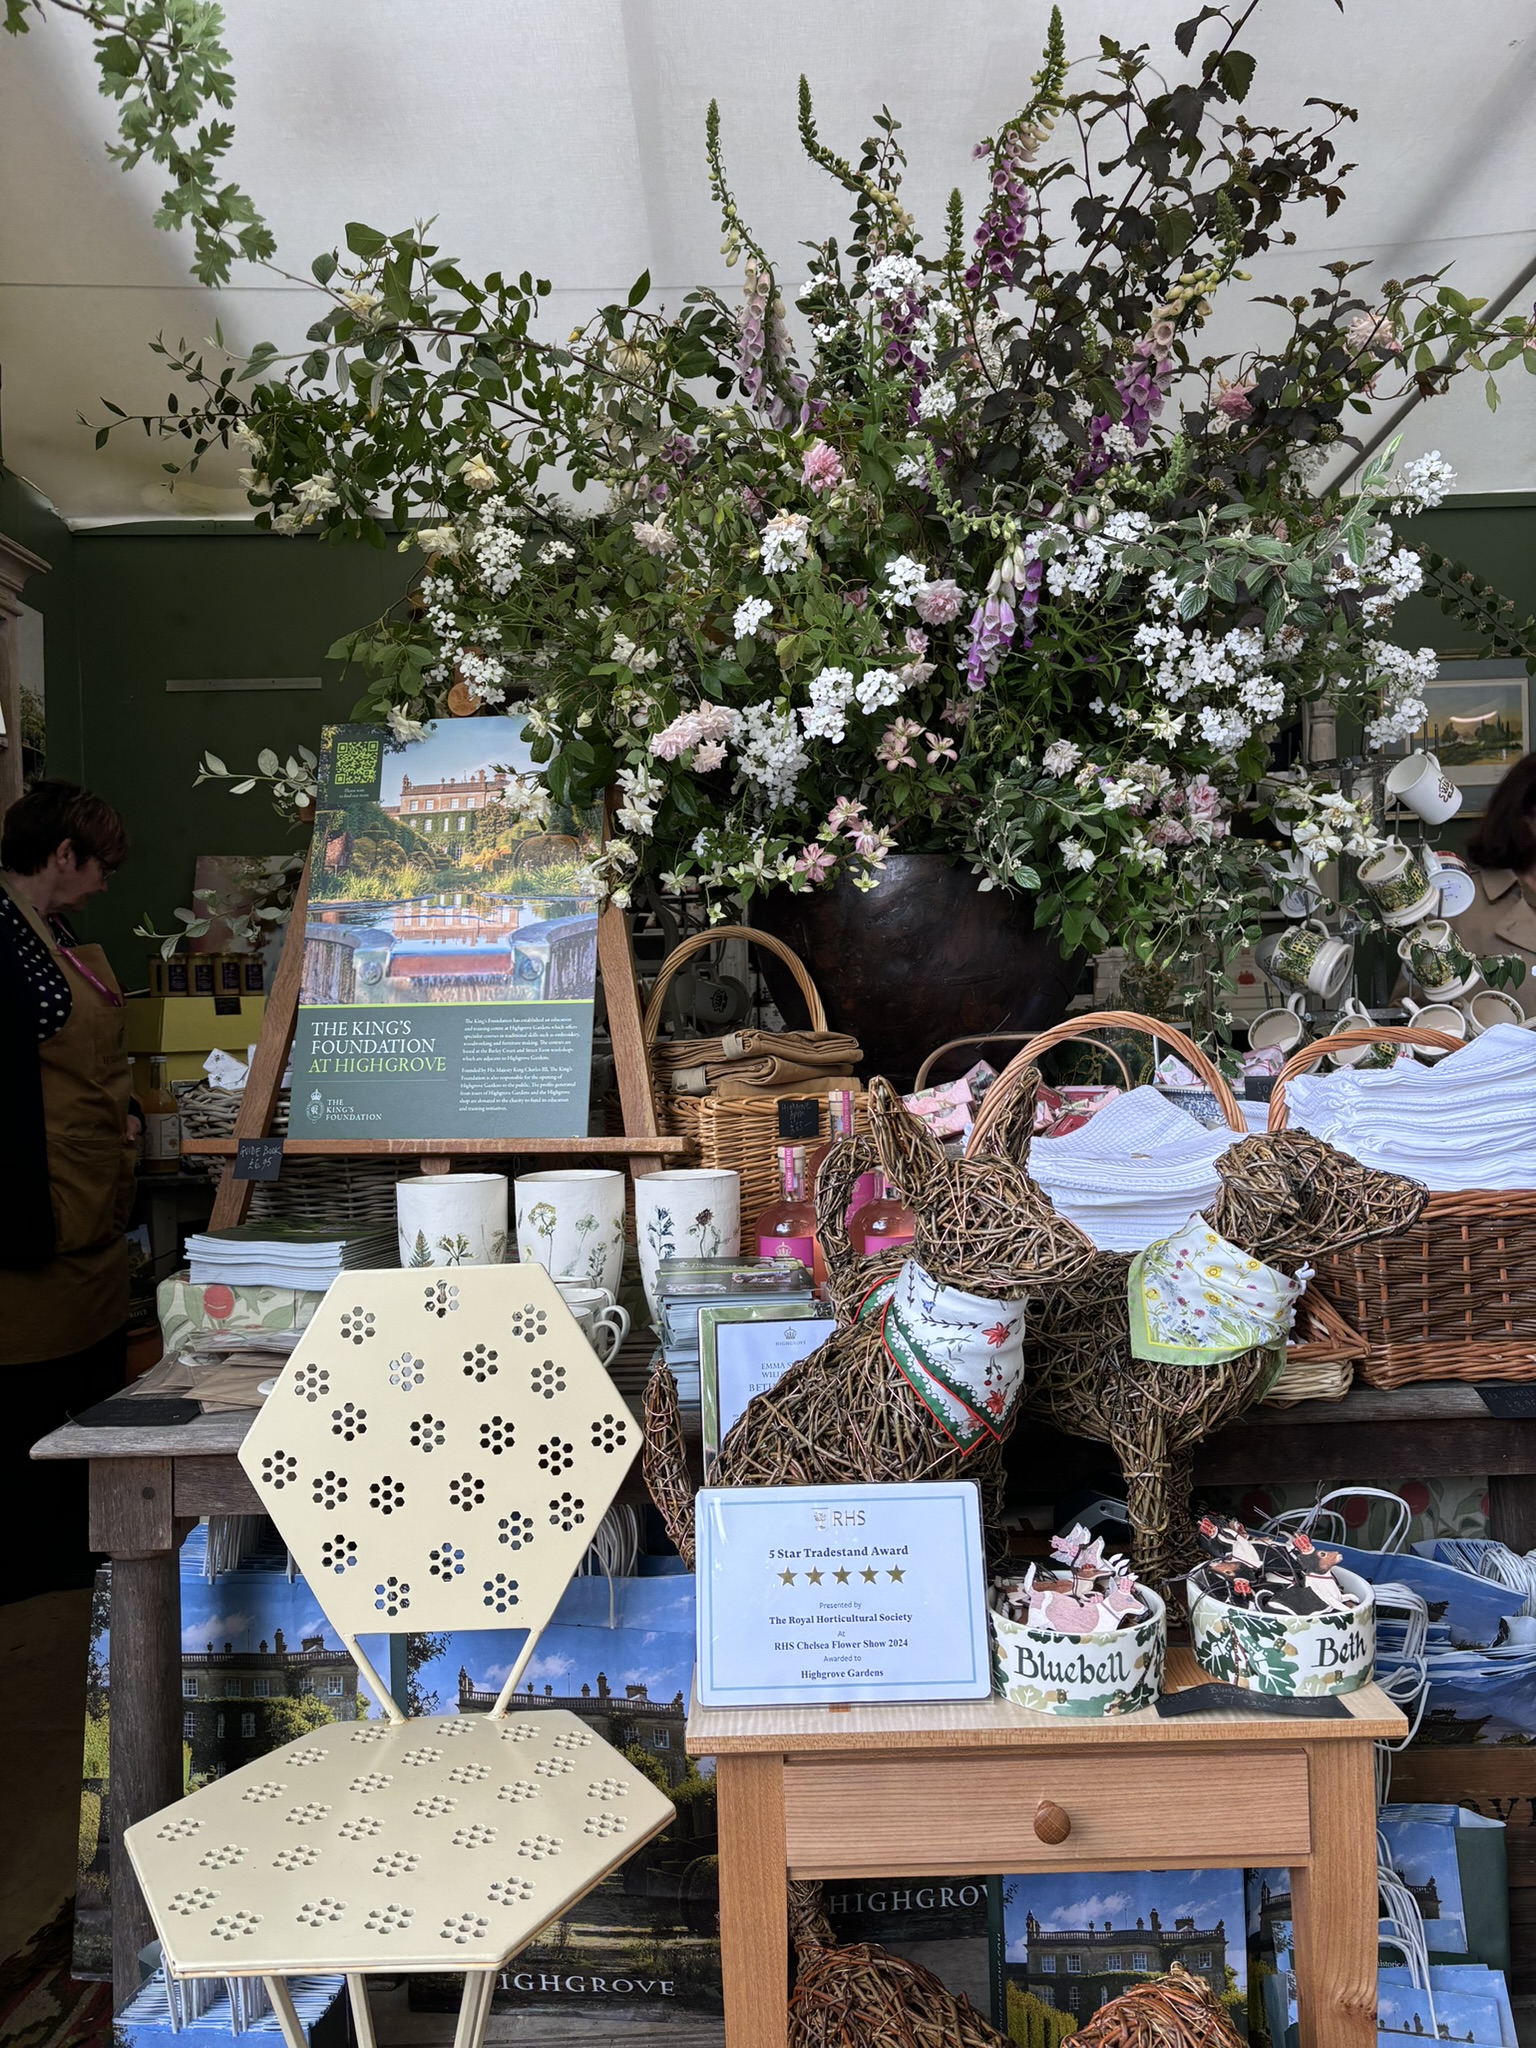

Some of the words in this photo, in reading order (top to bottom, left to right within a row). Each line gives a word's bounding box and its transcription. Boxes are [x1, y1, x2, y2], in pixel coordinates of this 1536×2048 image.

[311, 1021, 348, 1036] THE
[352, 1020, 412, 1036] KING'S
[311, 1038, 436, 1054] FOUNDATION
[308, 1058, 332, 1072] AT
[334, 1056, 446, 1072] HIGHGROVE
[326, 1106, 354, 1114] KING'S
[762, 1362, 786, 1370] EMMA
[832, 1510, 866, 1526] RHS
[768, 1549, 776, 1559] 5
[778, 1548, 802, 1559] Star
[803, 1546, 868, 1558] Tradestand
[871, 1545, 909, 1556] Award
[854, 1601, 862, 1610] by
[769, 1616, 787, 1625] The
[788, 1616, 815, 1626] Royal
[816, 1614, 878, 1624] Horticultural
[880, 1612, 913, 1623] Society
[838, 1630, 846, 1638] At
[774, 1642, 795, 1651] RHS
[796, 1641, 830, 1650] Chelsea
[832, 1640, 862, 1650] Flower
[863, 1639, 887, 1648] Show
[888, 1638, 908, 1648] 2024
[1312, 1637, 1368, 1669] Beth
[1014, 1645, 1132, 1684] Bluebell
[801, 1670, 846, 1680] Highgrove
[847, 1668, 884, 1678] Gardens
[498, 1973, 676, 1996] IGHGROVE
